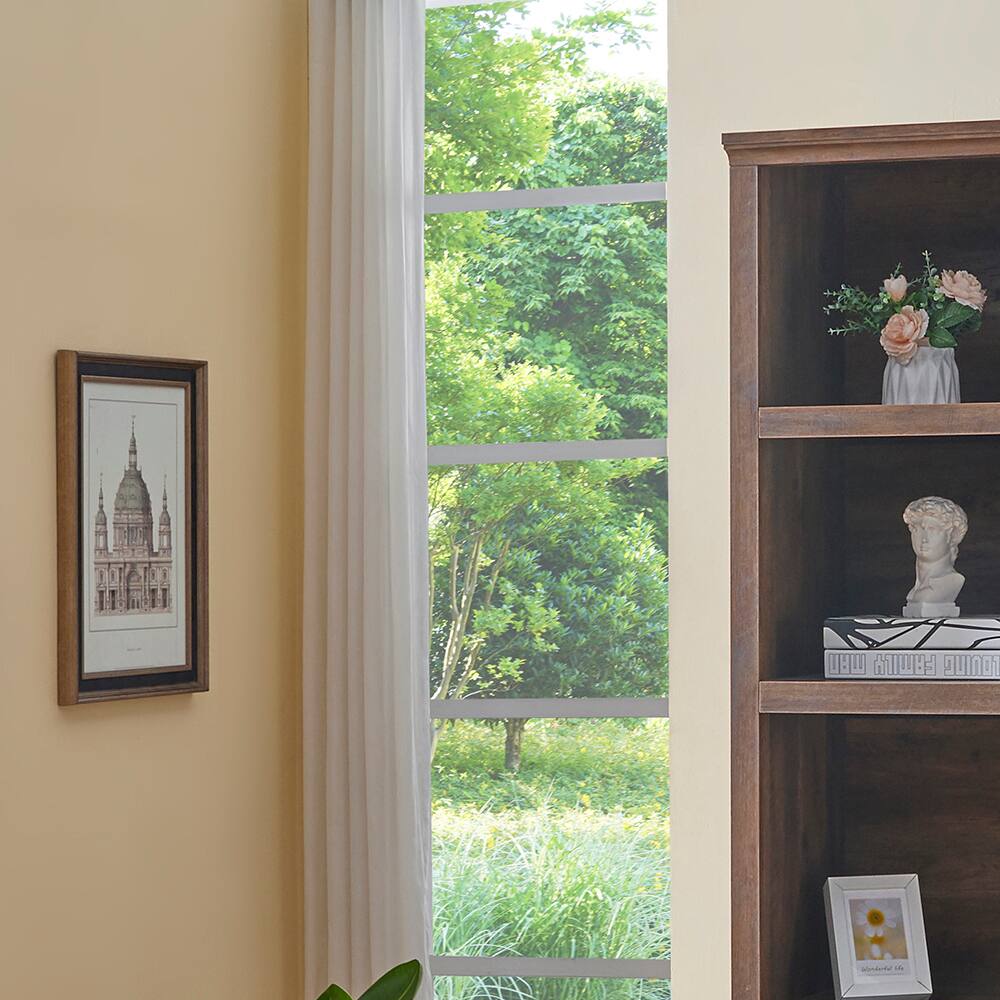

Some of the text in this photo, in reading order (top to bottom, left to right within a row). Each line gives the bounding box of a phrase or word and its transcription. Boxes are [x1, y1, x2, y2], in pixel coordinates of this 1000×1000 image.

[829, 653, 1000, 677] LOVING FAMILY MAN
